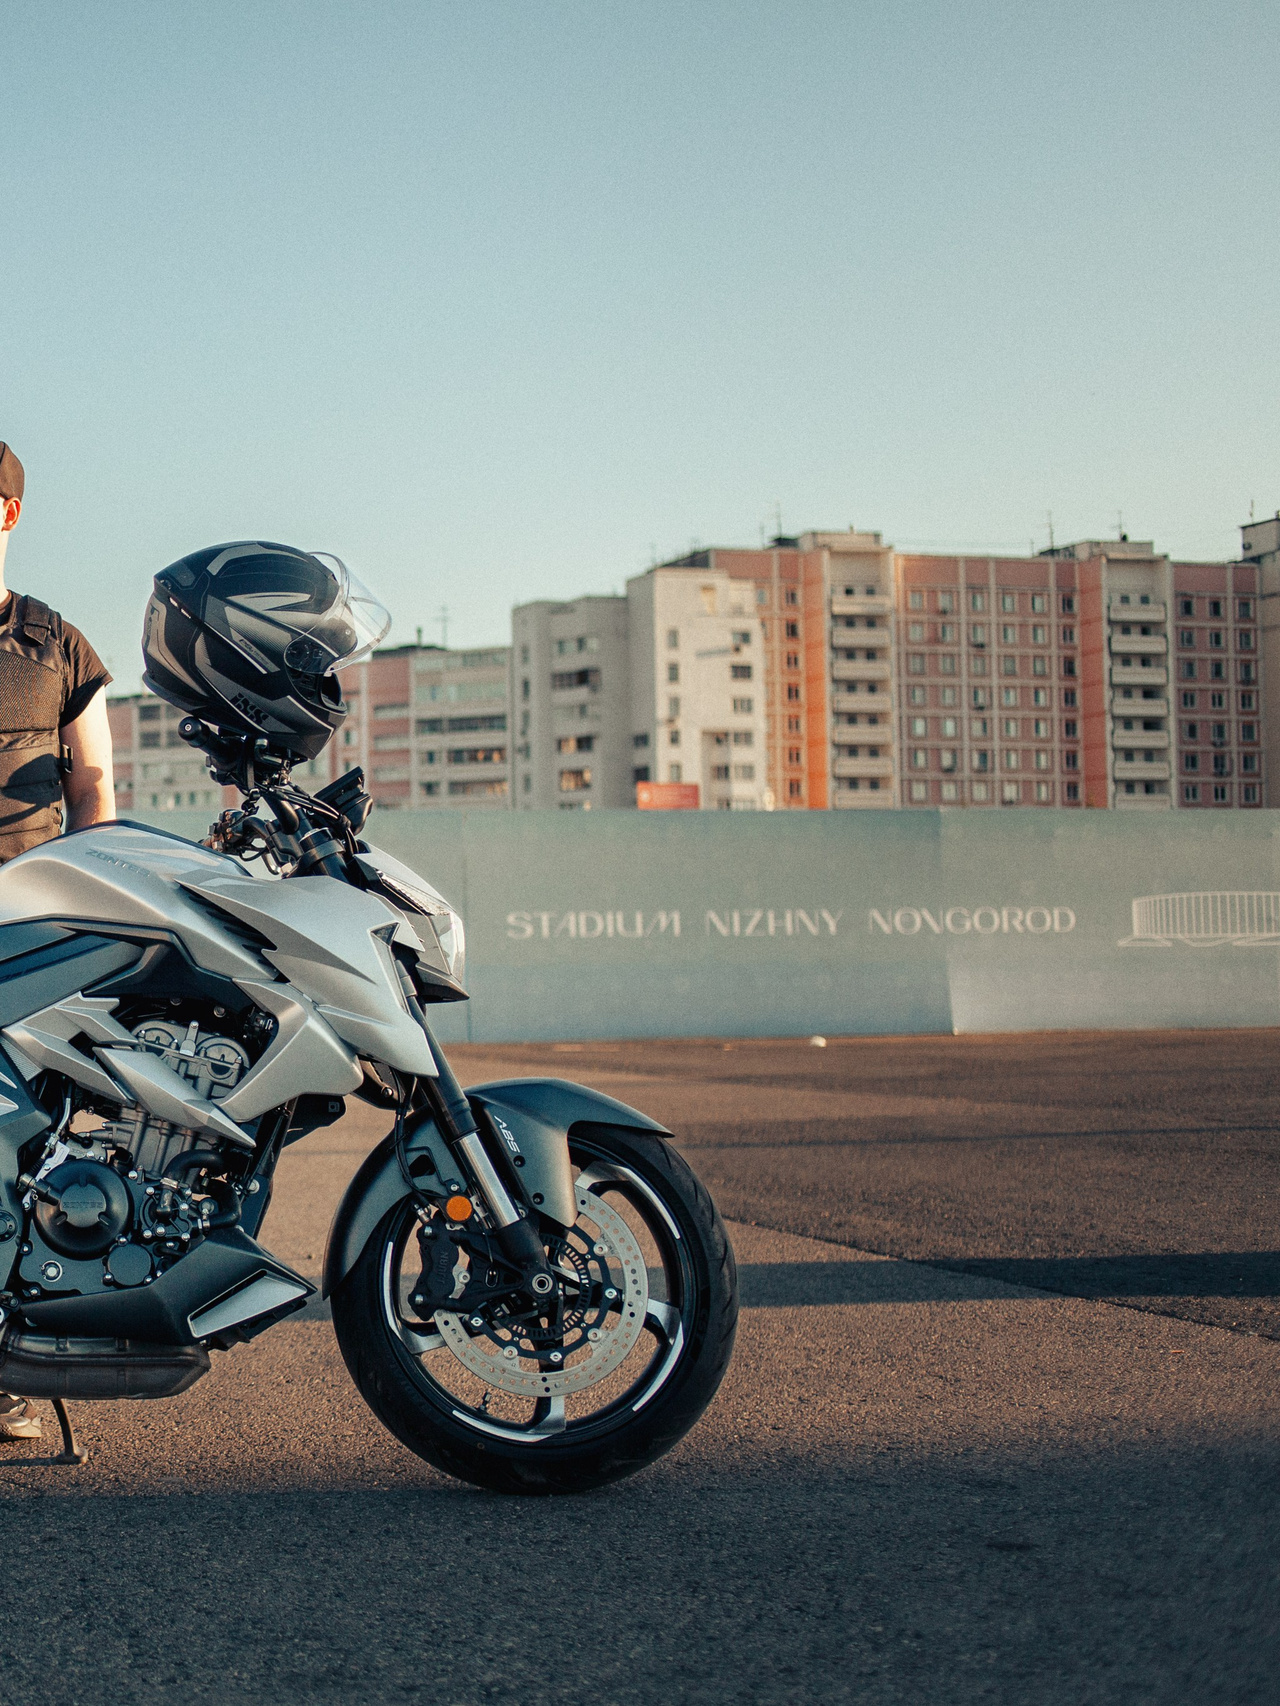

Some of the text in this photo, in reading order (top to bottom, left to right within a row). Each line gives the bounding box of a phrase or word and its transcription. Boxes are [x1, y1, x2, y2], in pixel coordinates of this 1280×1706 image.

[85, 848, 151, 878] ZONTES
[505, 906, 1077, 939] STADIUM NIZHNY NOVGOROD
[493, 1115, 521, 1153] ABS
